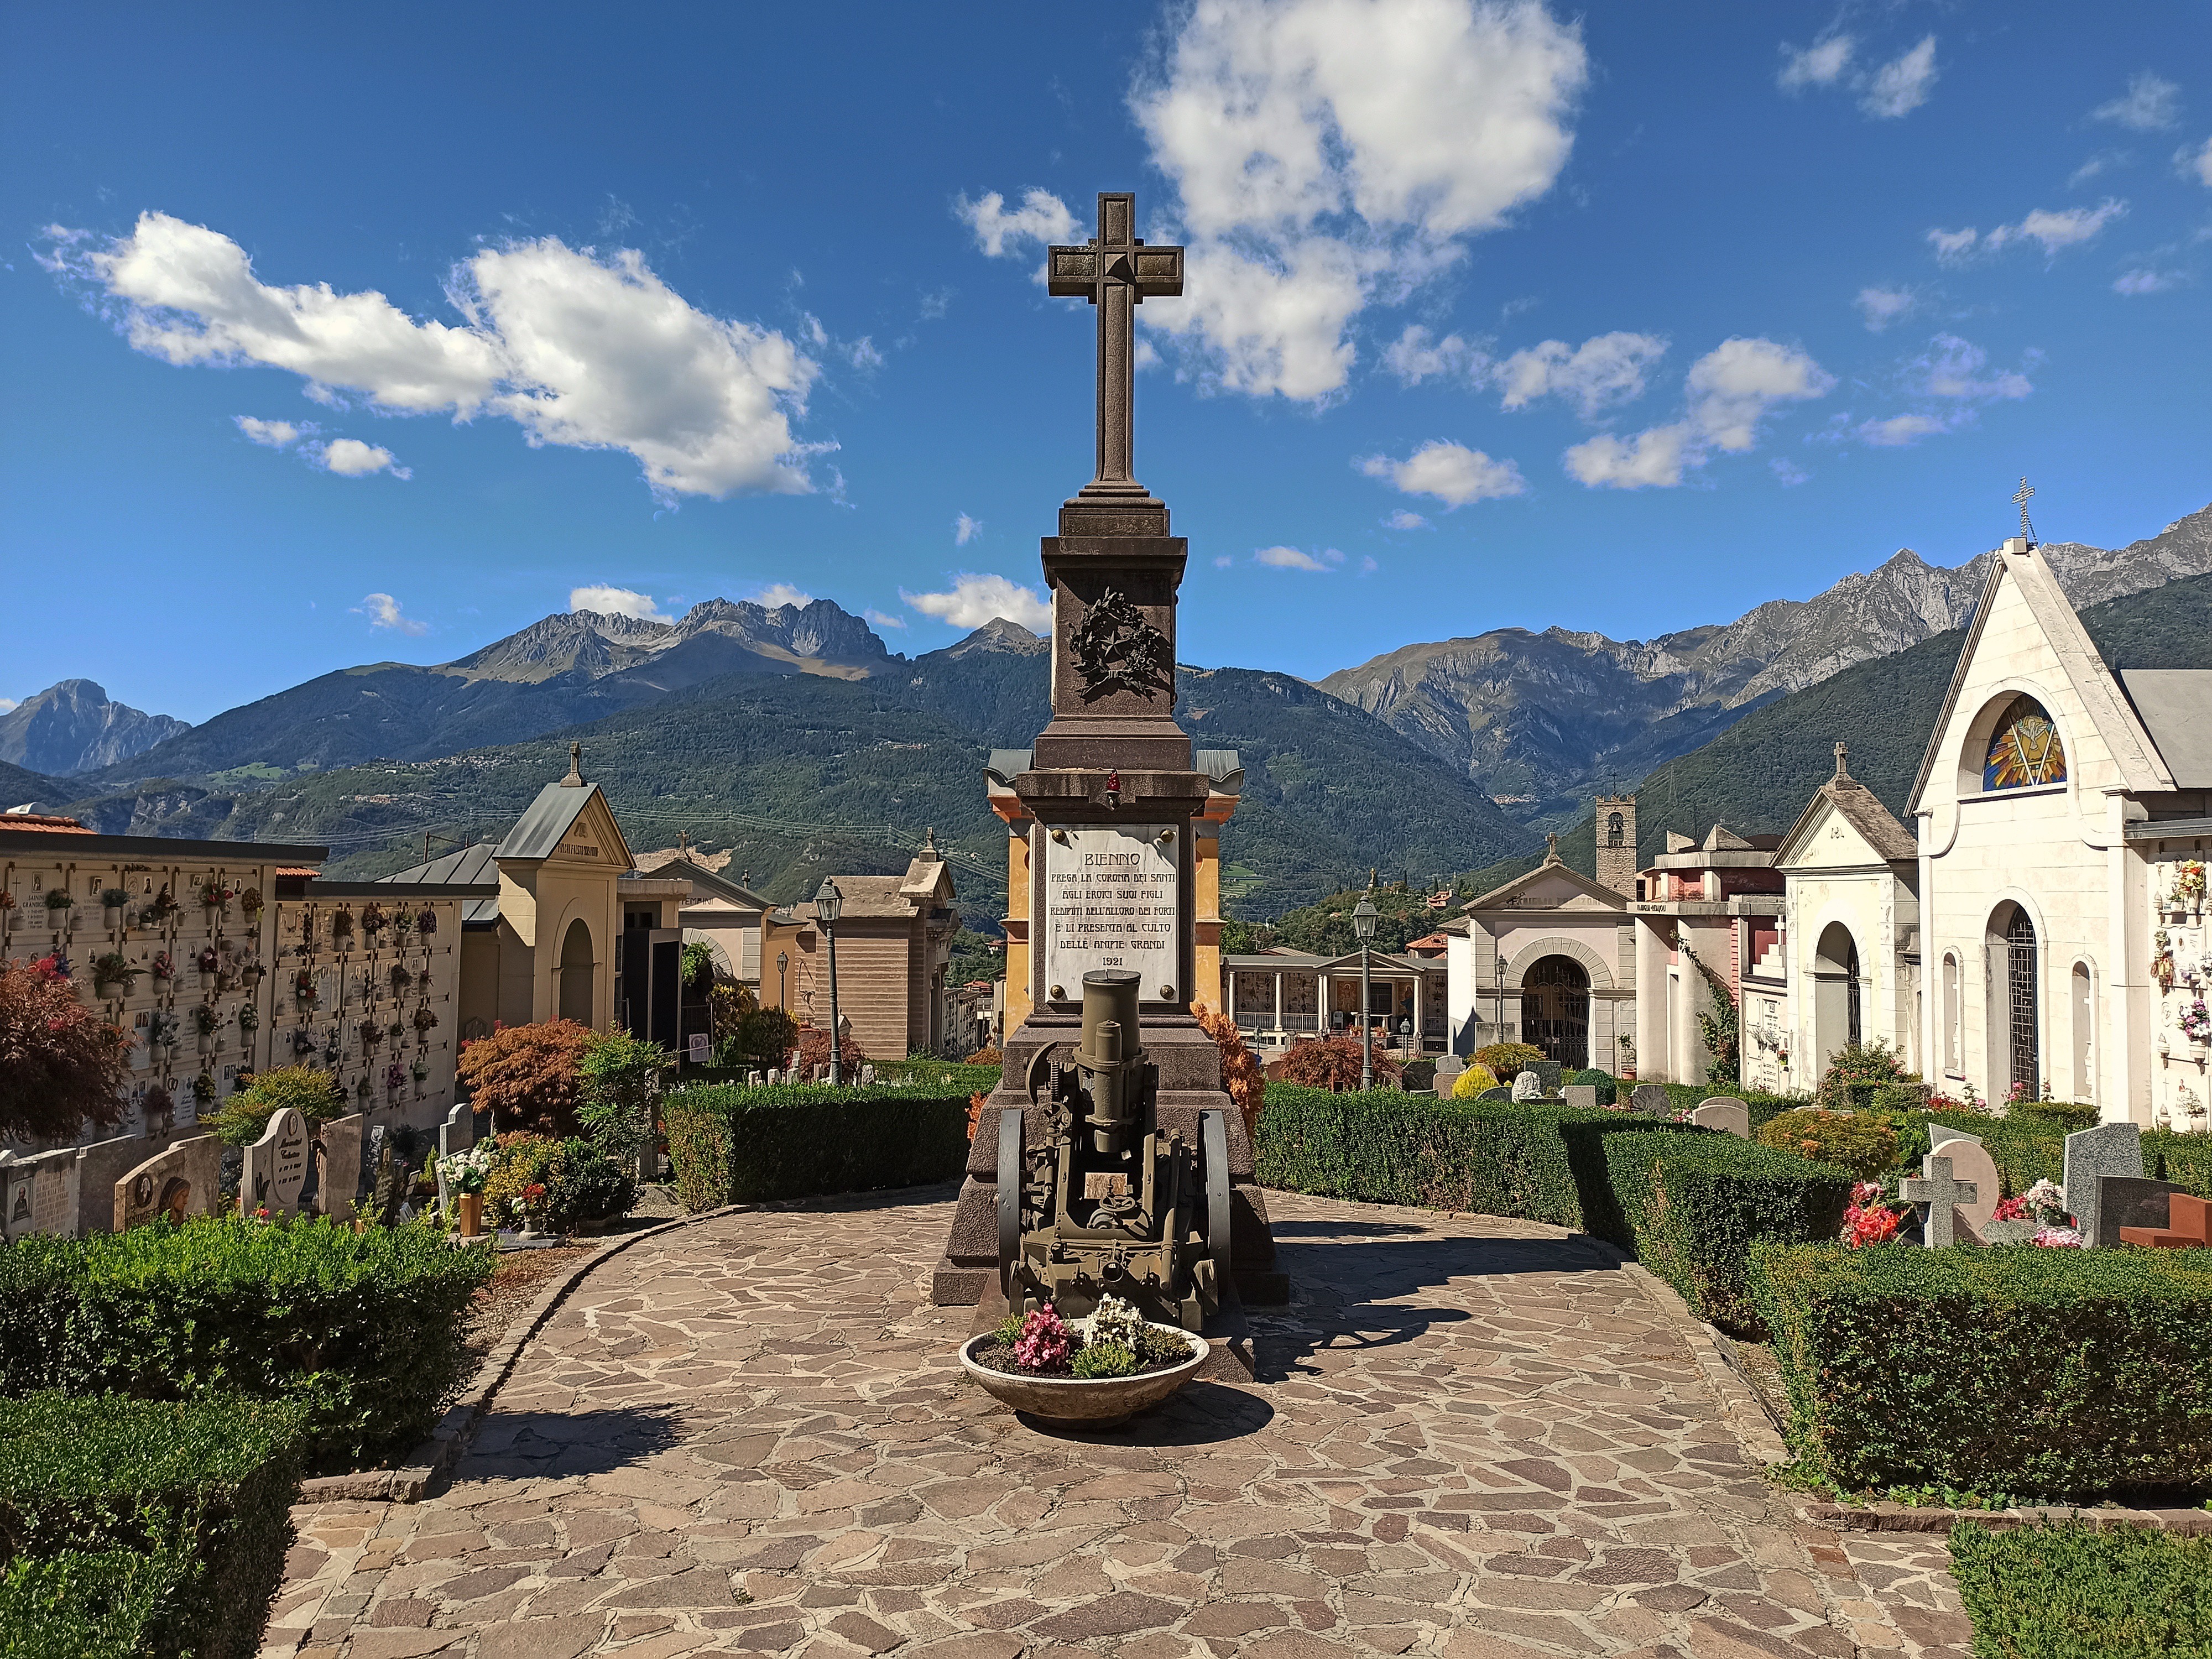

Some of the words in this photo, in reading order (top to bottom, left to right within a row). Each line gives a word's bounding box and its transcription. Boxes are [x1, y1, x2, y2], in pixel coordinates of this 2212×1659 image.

[1084, 853, 1140, 865] BIENNO
[1051, 874, 1077, 882] PREGA
[1081, 874, 1092, 882] LA
[1096, 874, 1130, 882] CORONA
[1134, 874, 1146, 883] DEI
[1150, 874, 1175, 882] SANTI
[1062, 890, 1082, 899] AGLI
[1086, 890, 1112, 899] EROICI
[1117, 890, 1137, 899] SUOI
[1141, 890, 1163, 899] FIGLI
[1050, 907, 1083, 915] REDIMITI
[1086, 906, 1135, 915] DELL'ALLORO
[1139, 907, 1151, 915] DEI
[1154, 907, 1175, 915] FORTI
[1066, 924, 1074, 932] LI
[1078, 924, 1123, 932] PRESENTA
[1126, 924, 1138, 932] AL
[1142, 924, 1171, 932] CULTO
[1060, 941, 1088, 949] DELLE
[1094, 941, 1125, 949] ANIME
[1131, 941, 1165, 949] GRANDI
[1103, 957, 1123, 966] 1921
